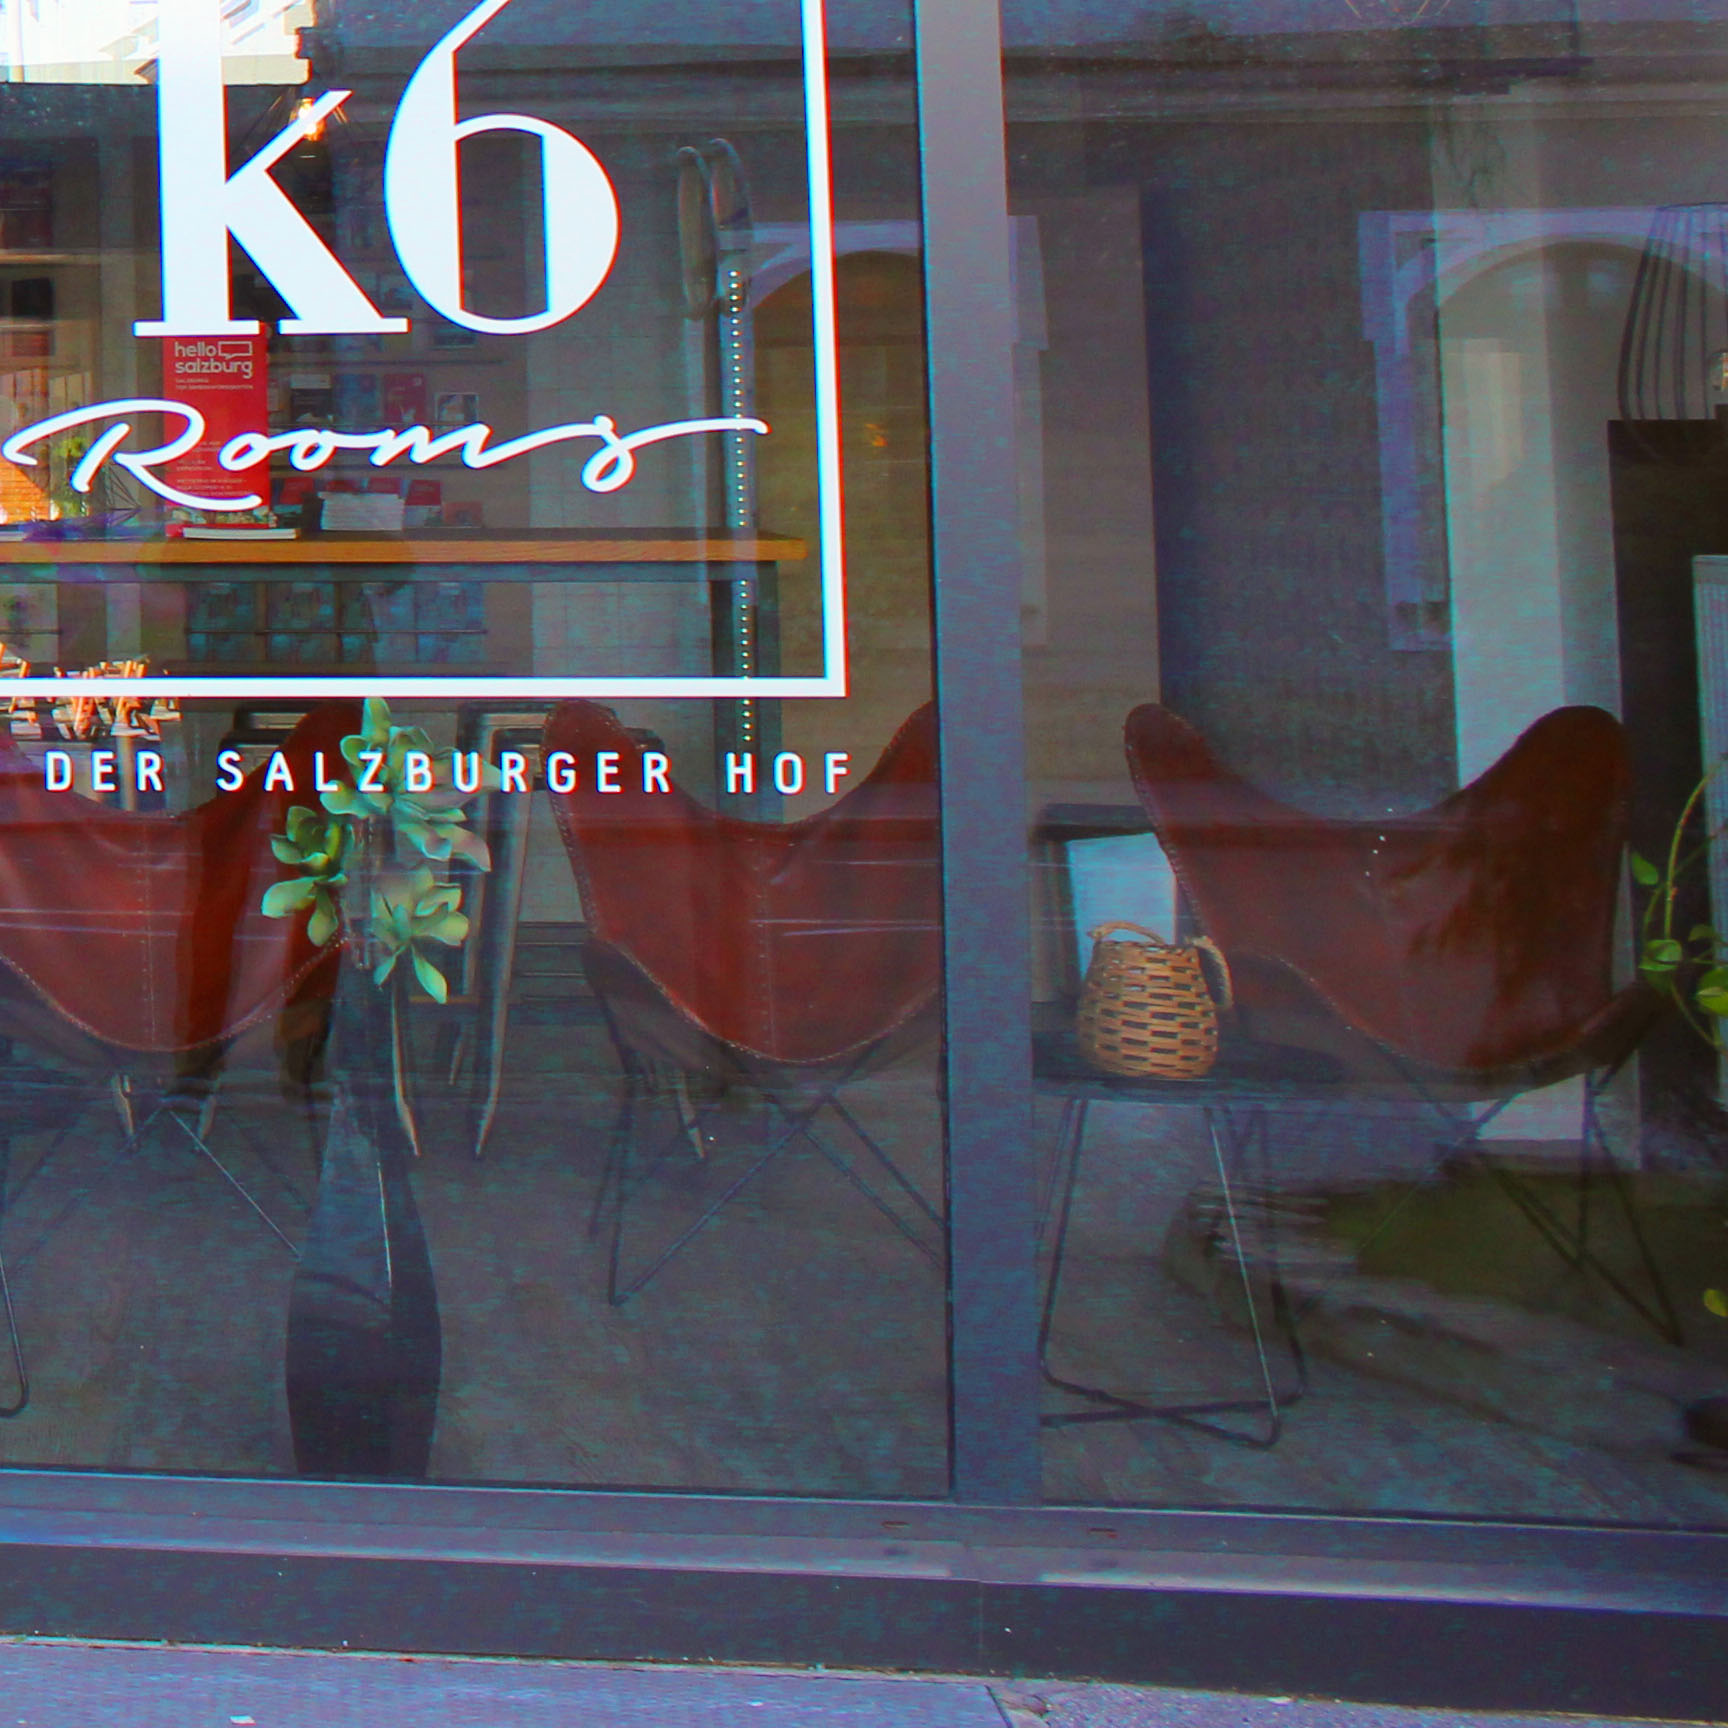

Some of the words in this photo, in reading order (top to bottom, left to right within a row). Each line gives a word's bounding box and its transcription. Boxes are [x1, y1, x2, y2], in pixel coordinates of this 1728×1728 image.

[174, 341, 217, 357] hello
[175, 358, 253, 379] salzburg
[2, 398, 769, 511] Rooms
[43, 750, 165, 793] DER
[215, 750, 673, 795] SALZBURGER
[725, 751, 851, 795] HOF
